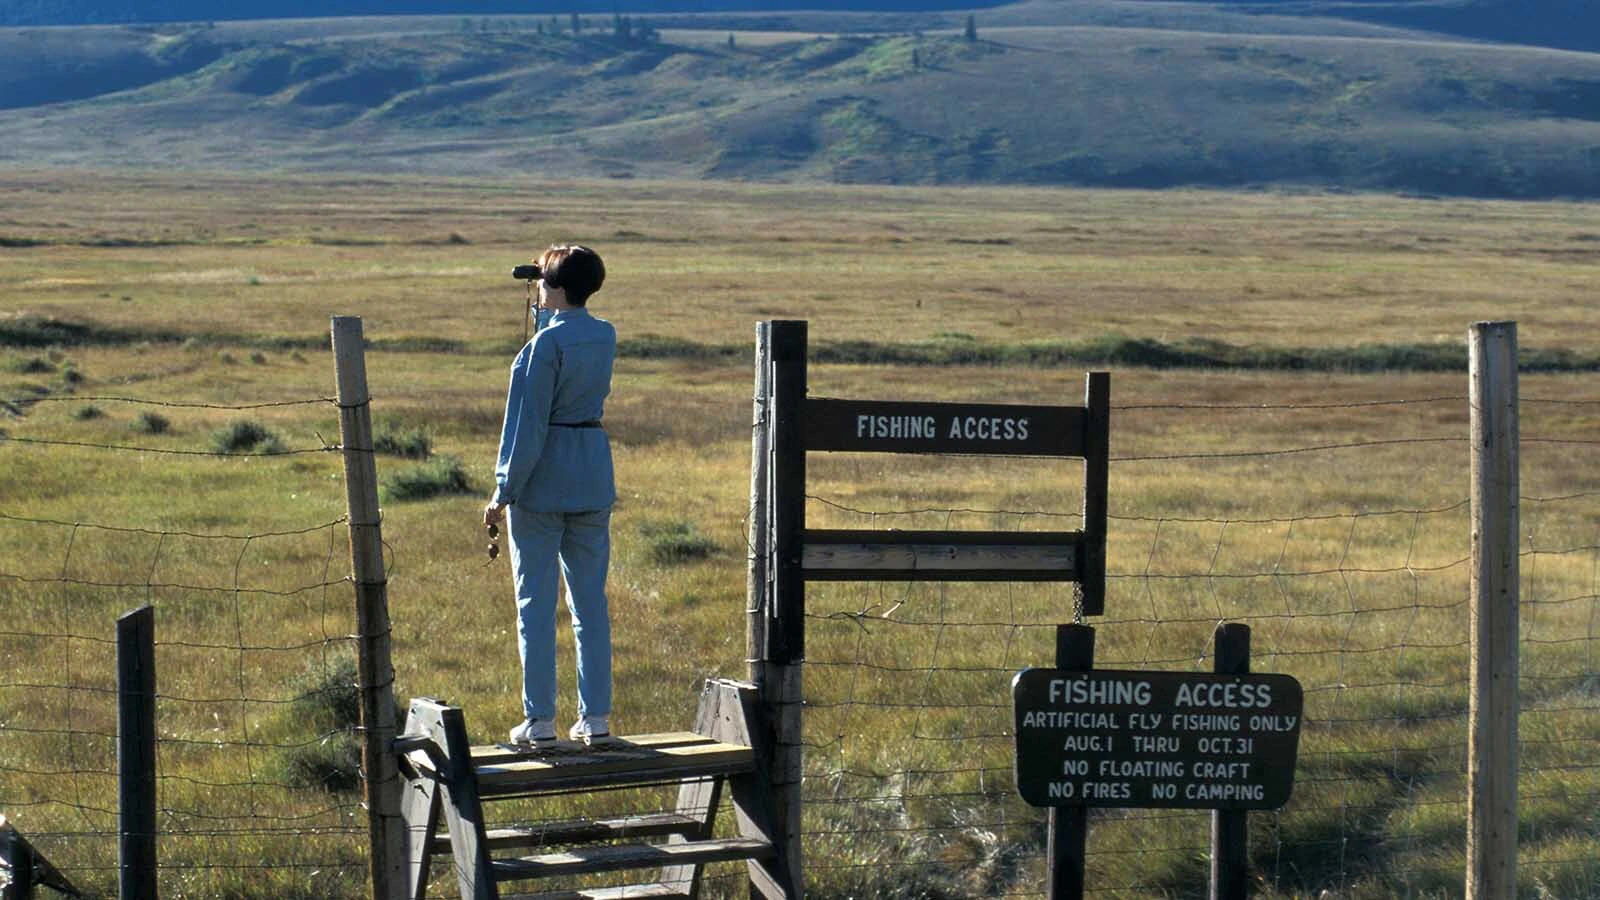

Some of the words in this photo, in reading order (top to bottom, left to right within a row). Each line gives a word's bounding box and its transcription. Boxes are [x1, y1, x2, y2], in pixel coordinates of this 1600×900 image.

[857, 415, 936, 438] FISHING
[950, 416, 1029, 440] ACCESS
[1050, 680, 1151, 706] FISHING
[1175, 683, 1272, 708] ACCESS
[1023, 711, 1119, 729] ARTIFICIAL
[1129, 713, 1161, 730] FLY
[1172, 714, 1240, 731] FISHING
[1250, 715, 1297, 732] ONLY
[1133, 736, 1180, 753] THRU
[1064, 760, 1089, 776] NO
[1100, 760, 1184, 778] FLOATING
[1193, 762, 1250, 779] CRAFT
[1049, 782, 1074, 799] NO
[1082, 783, 1131, 799] FIRES
[1152, 784, 1177, 800] NO
[1185, 784, 1264, 801] CAMPING
